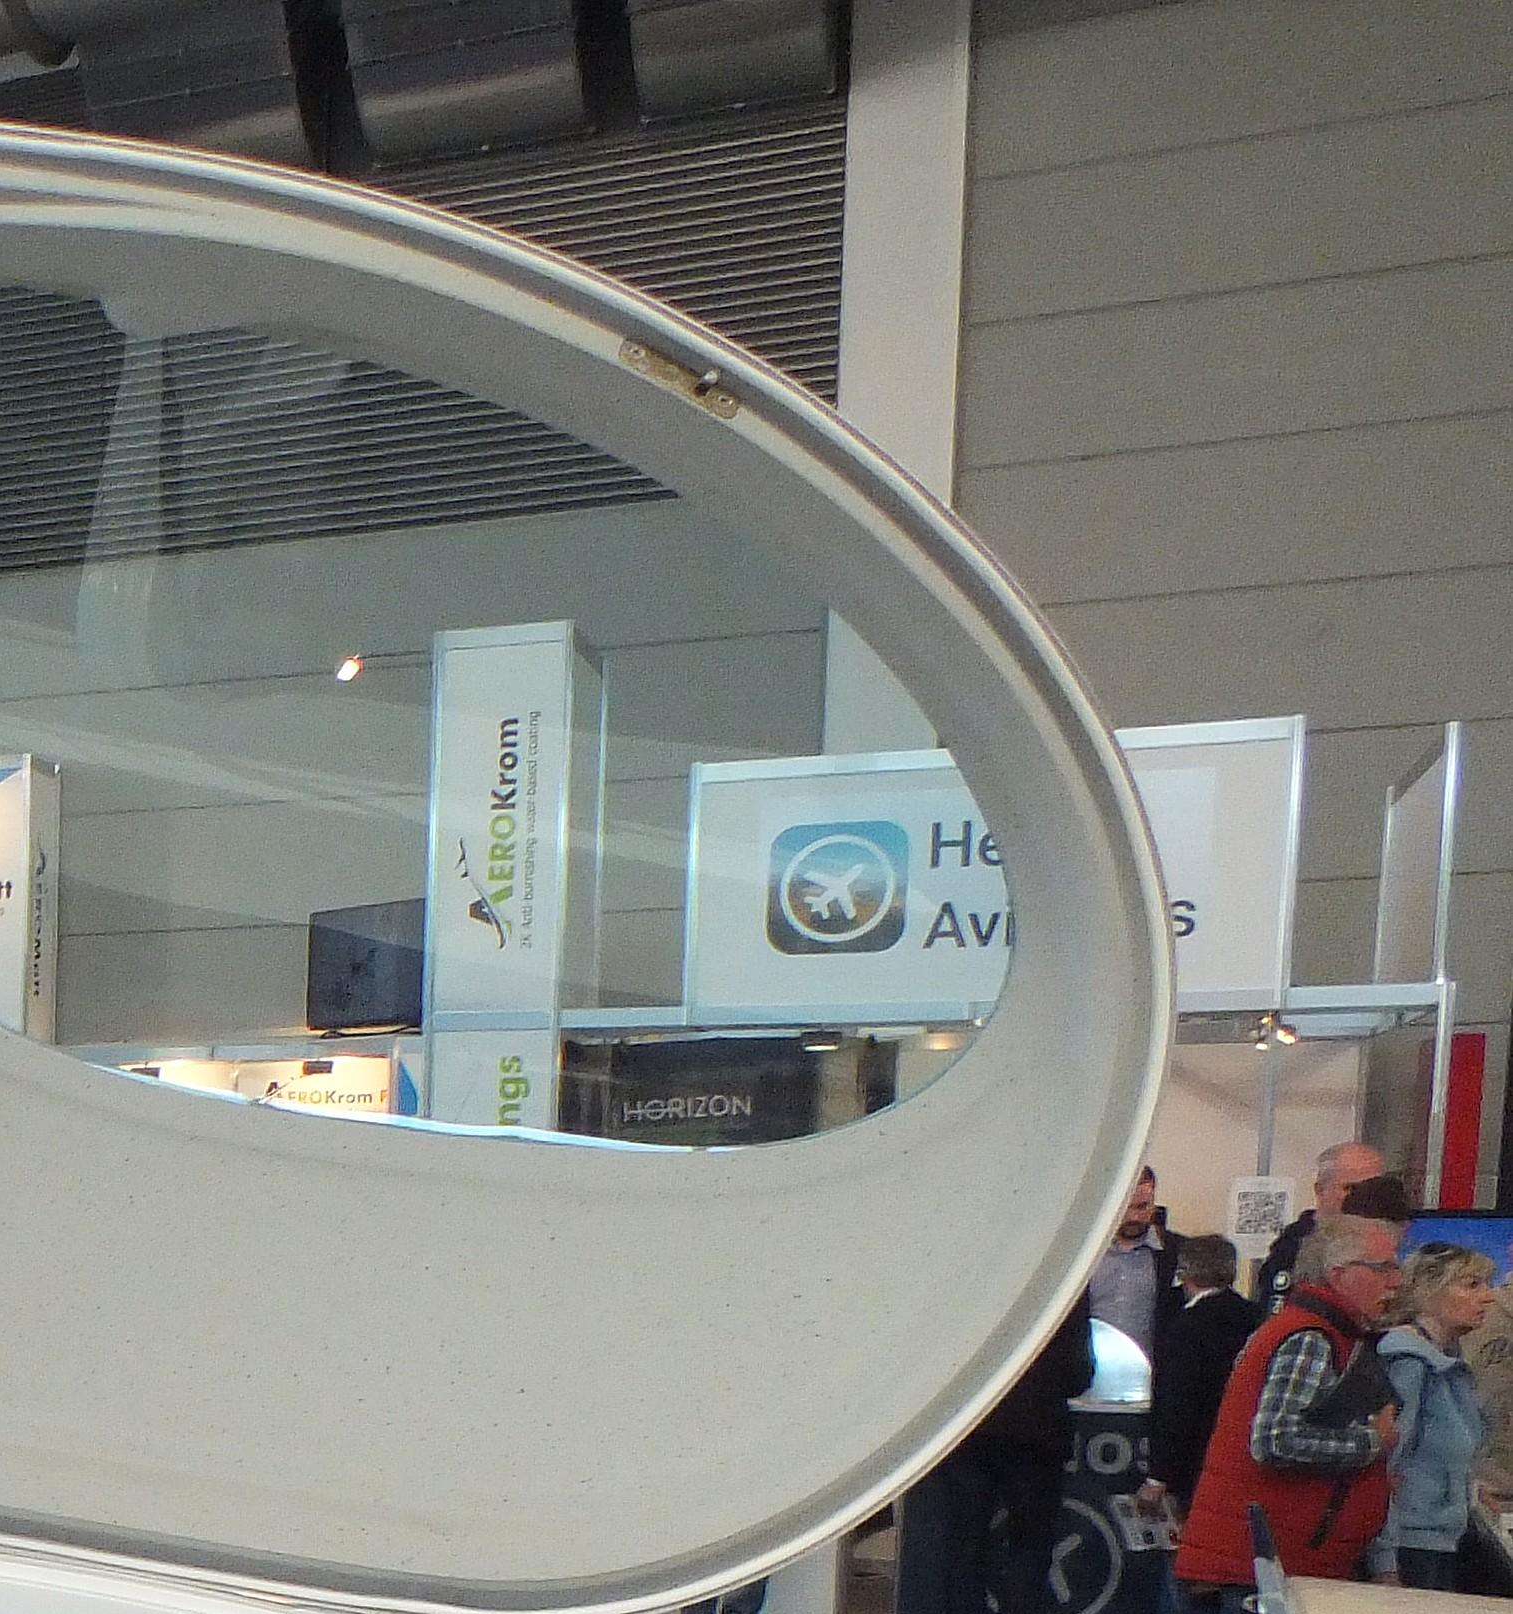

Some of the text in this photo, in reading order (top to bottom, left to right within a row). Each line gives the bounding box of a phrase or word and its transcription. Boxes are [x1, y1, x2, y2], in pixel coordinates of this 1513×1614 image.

[930, 820, 1005, 869] He
[497, 1055, 529, 1126] ngs
[624, 1095, 752, 1122] HORIZON
